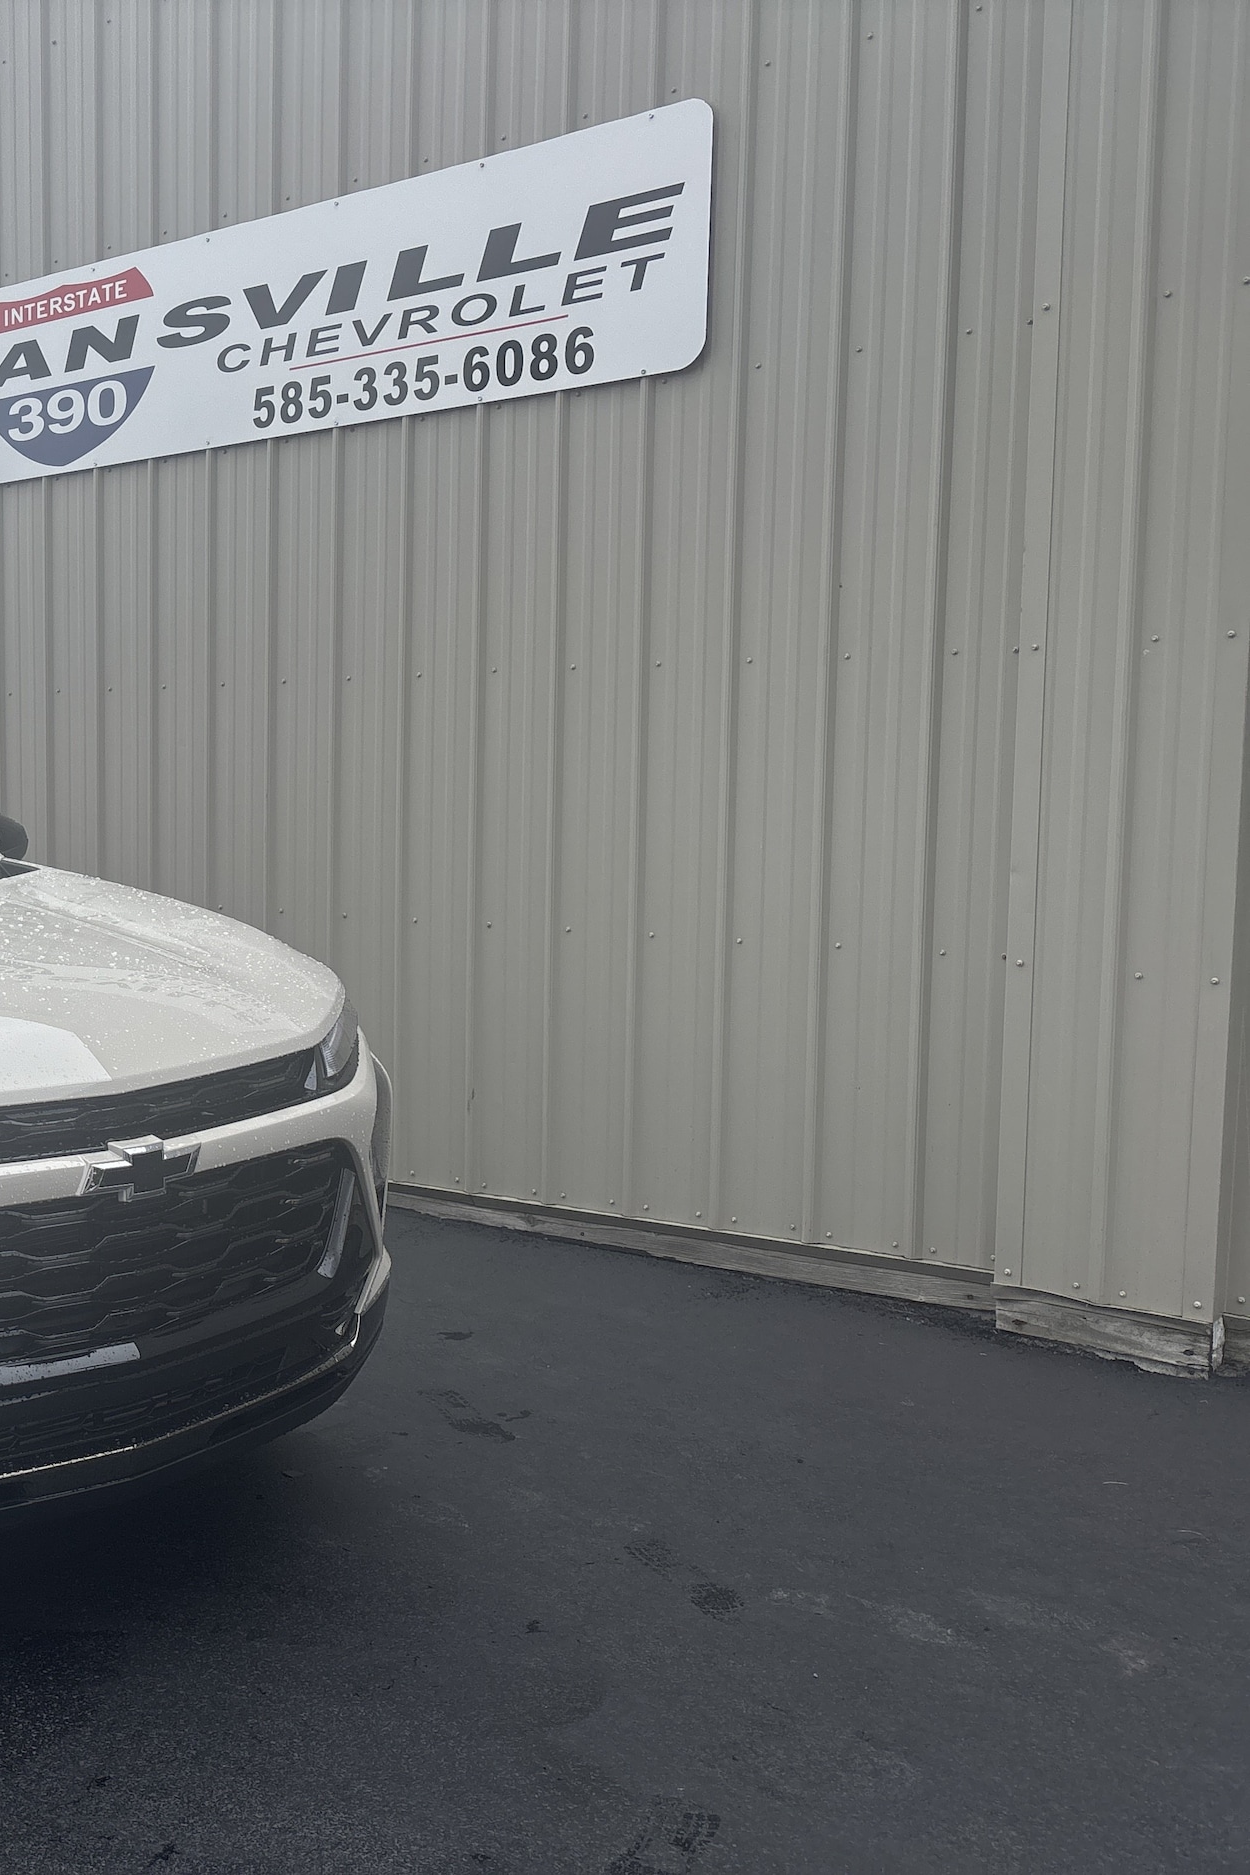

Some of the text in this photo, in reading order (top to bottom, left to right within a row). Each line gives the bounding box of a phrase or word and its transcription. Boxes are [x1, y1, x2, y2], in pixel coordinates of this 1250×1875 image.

[4, 279, 128, 328] INTERSTATE
[216, 252, 666, 374] CHEVROLET
[7, 379, 128, 443] 390
[251, 326, 596, 429] 585-335-6086
